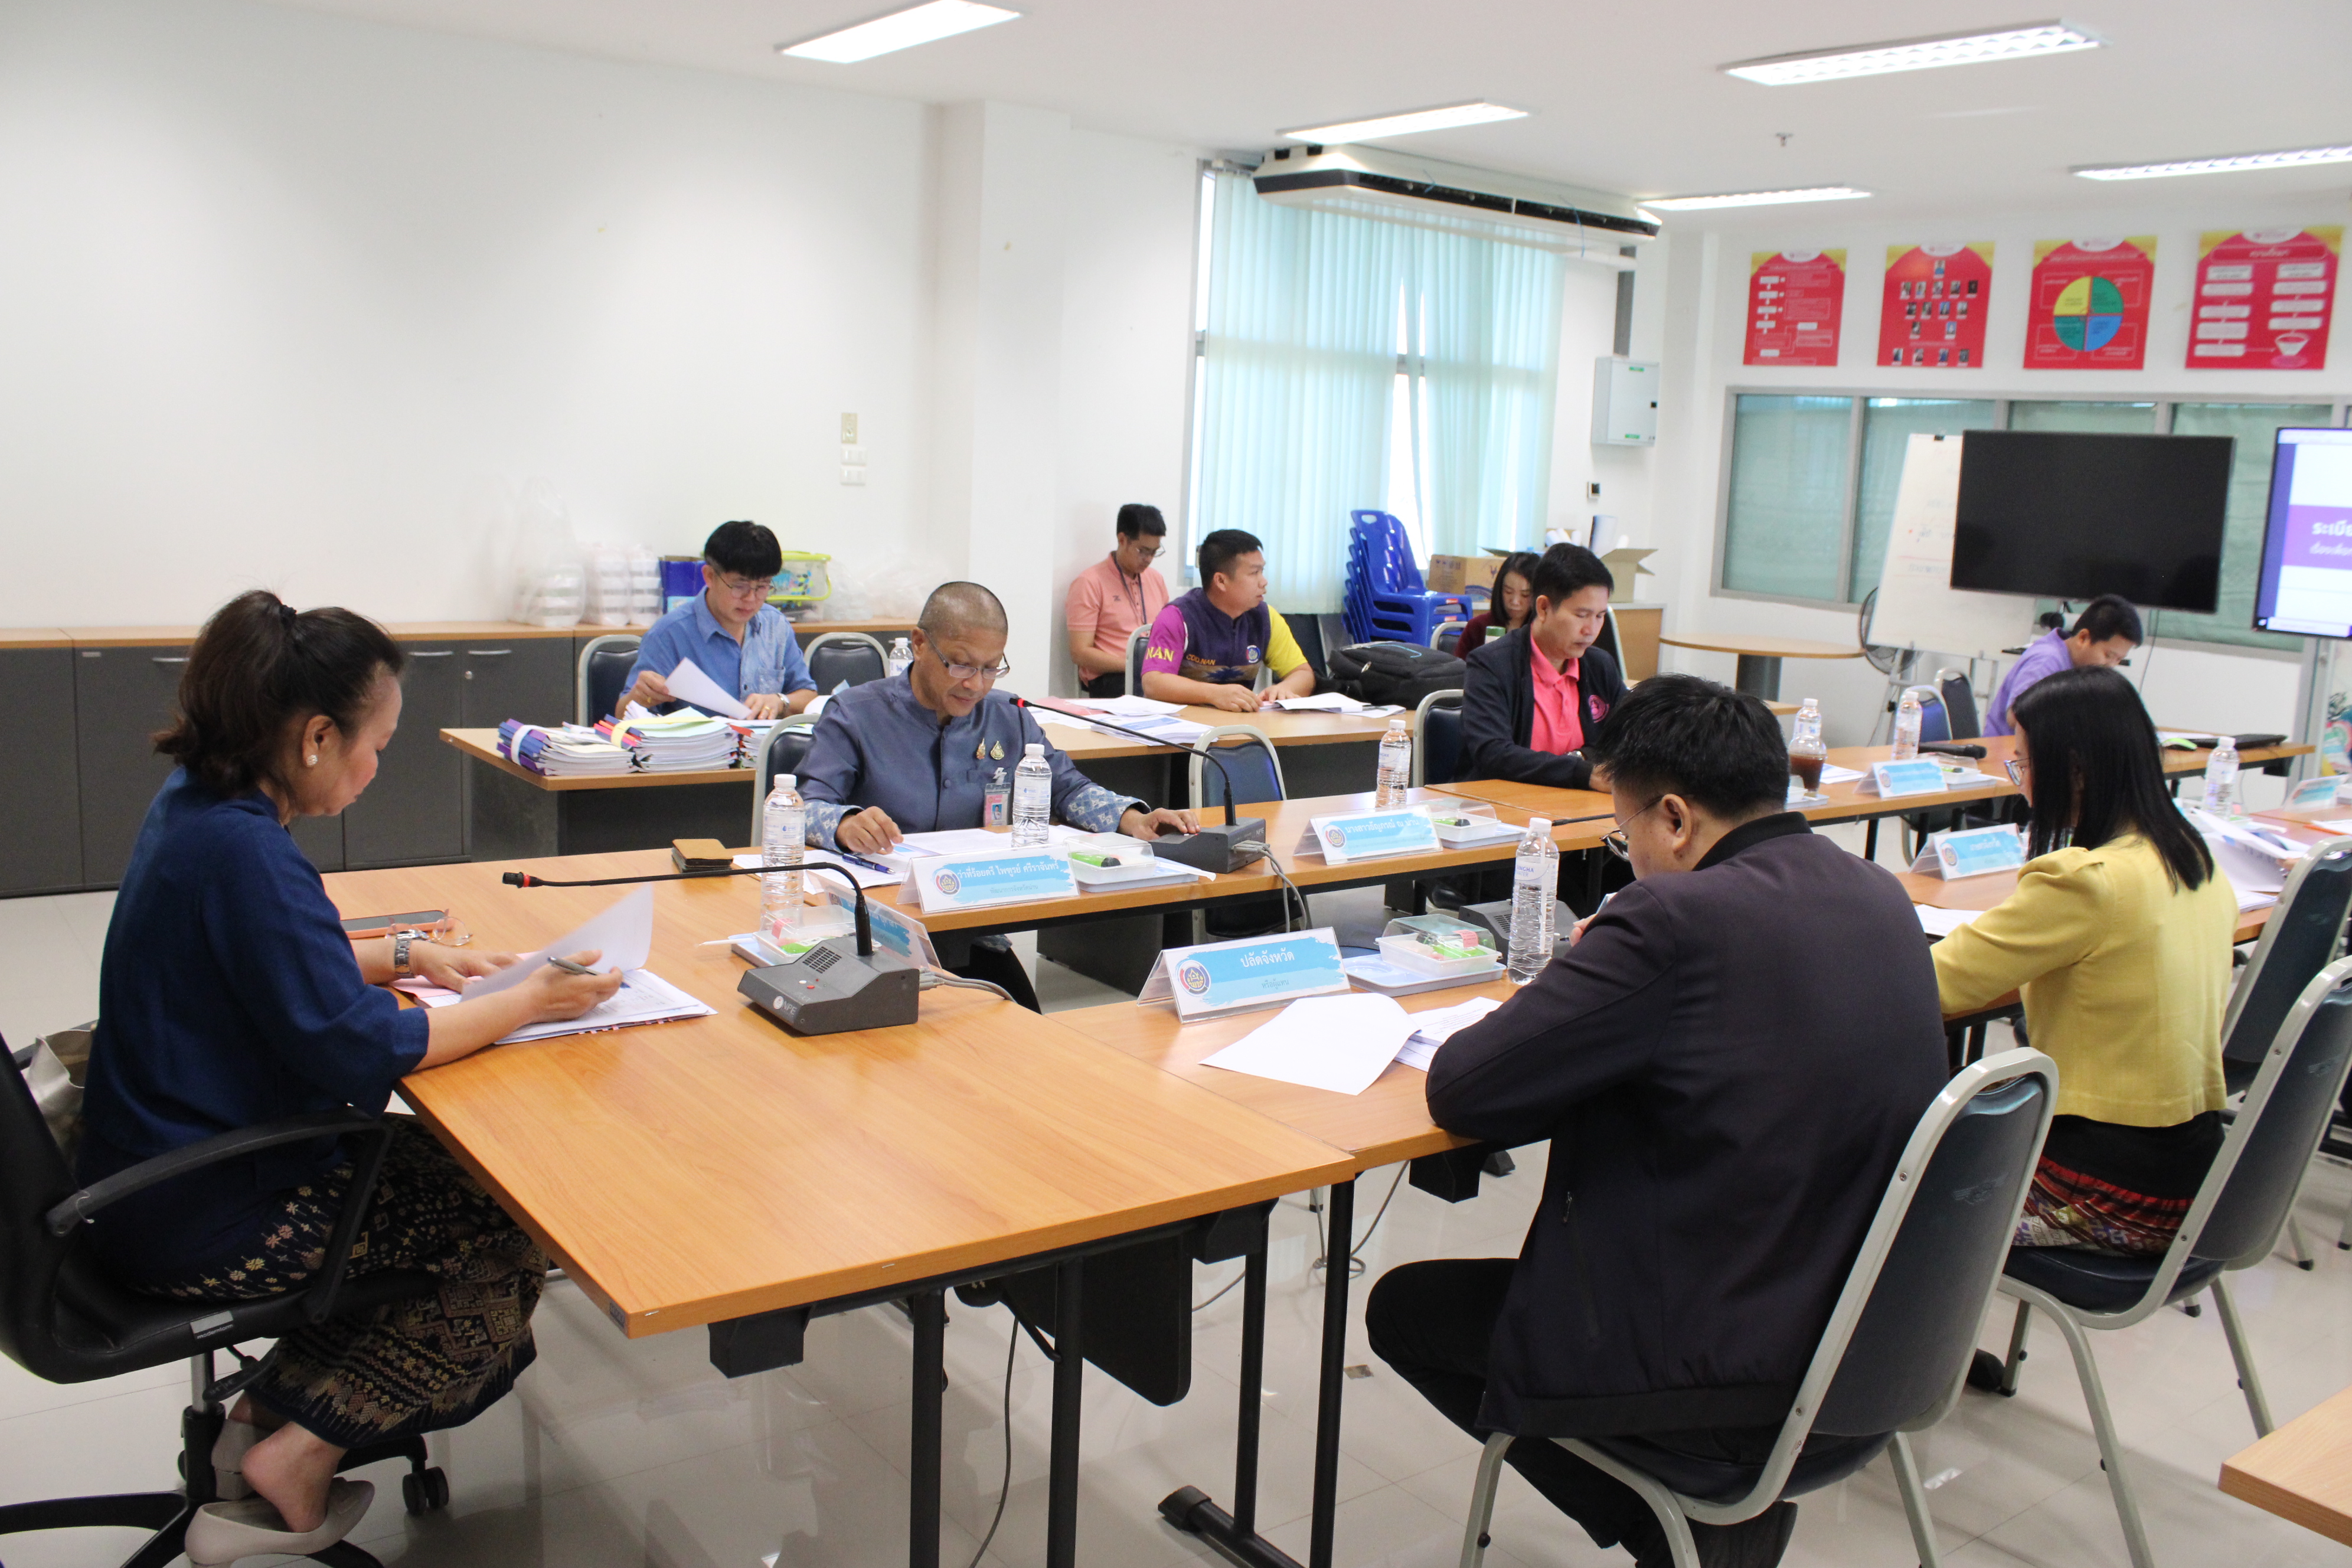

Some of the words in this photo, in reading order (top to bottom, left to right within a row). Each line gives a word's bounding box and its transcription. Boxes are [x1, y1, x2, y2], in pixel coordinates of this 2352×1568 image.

[1145, 646, 1174, 662] NAN
[1240, 947, 1295, 968] ปลัดจังหวัด
[1261, 978, 1289, 989] หรือผู้แทน
[197, 1324, 234, 1339] modernform
